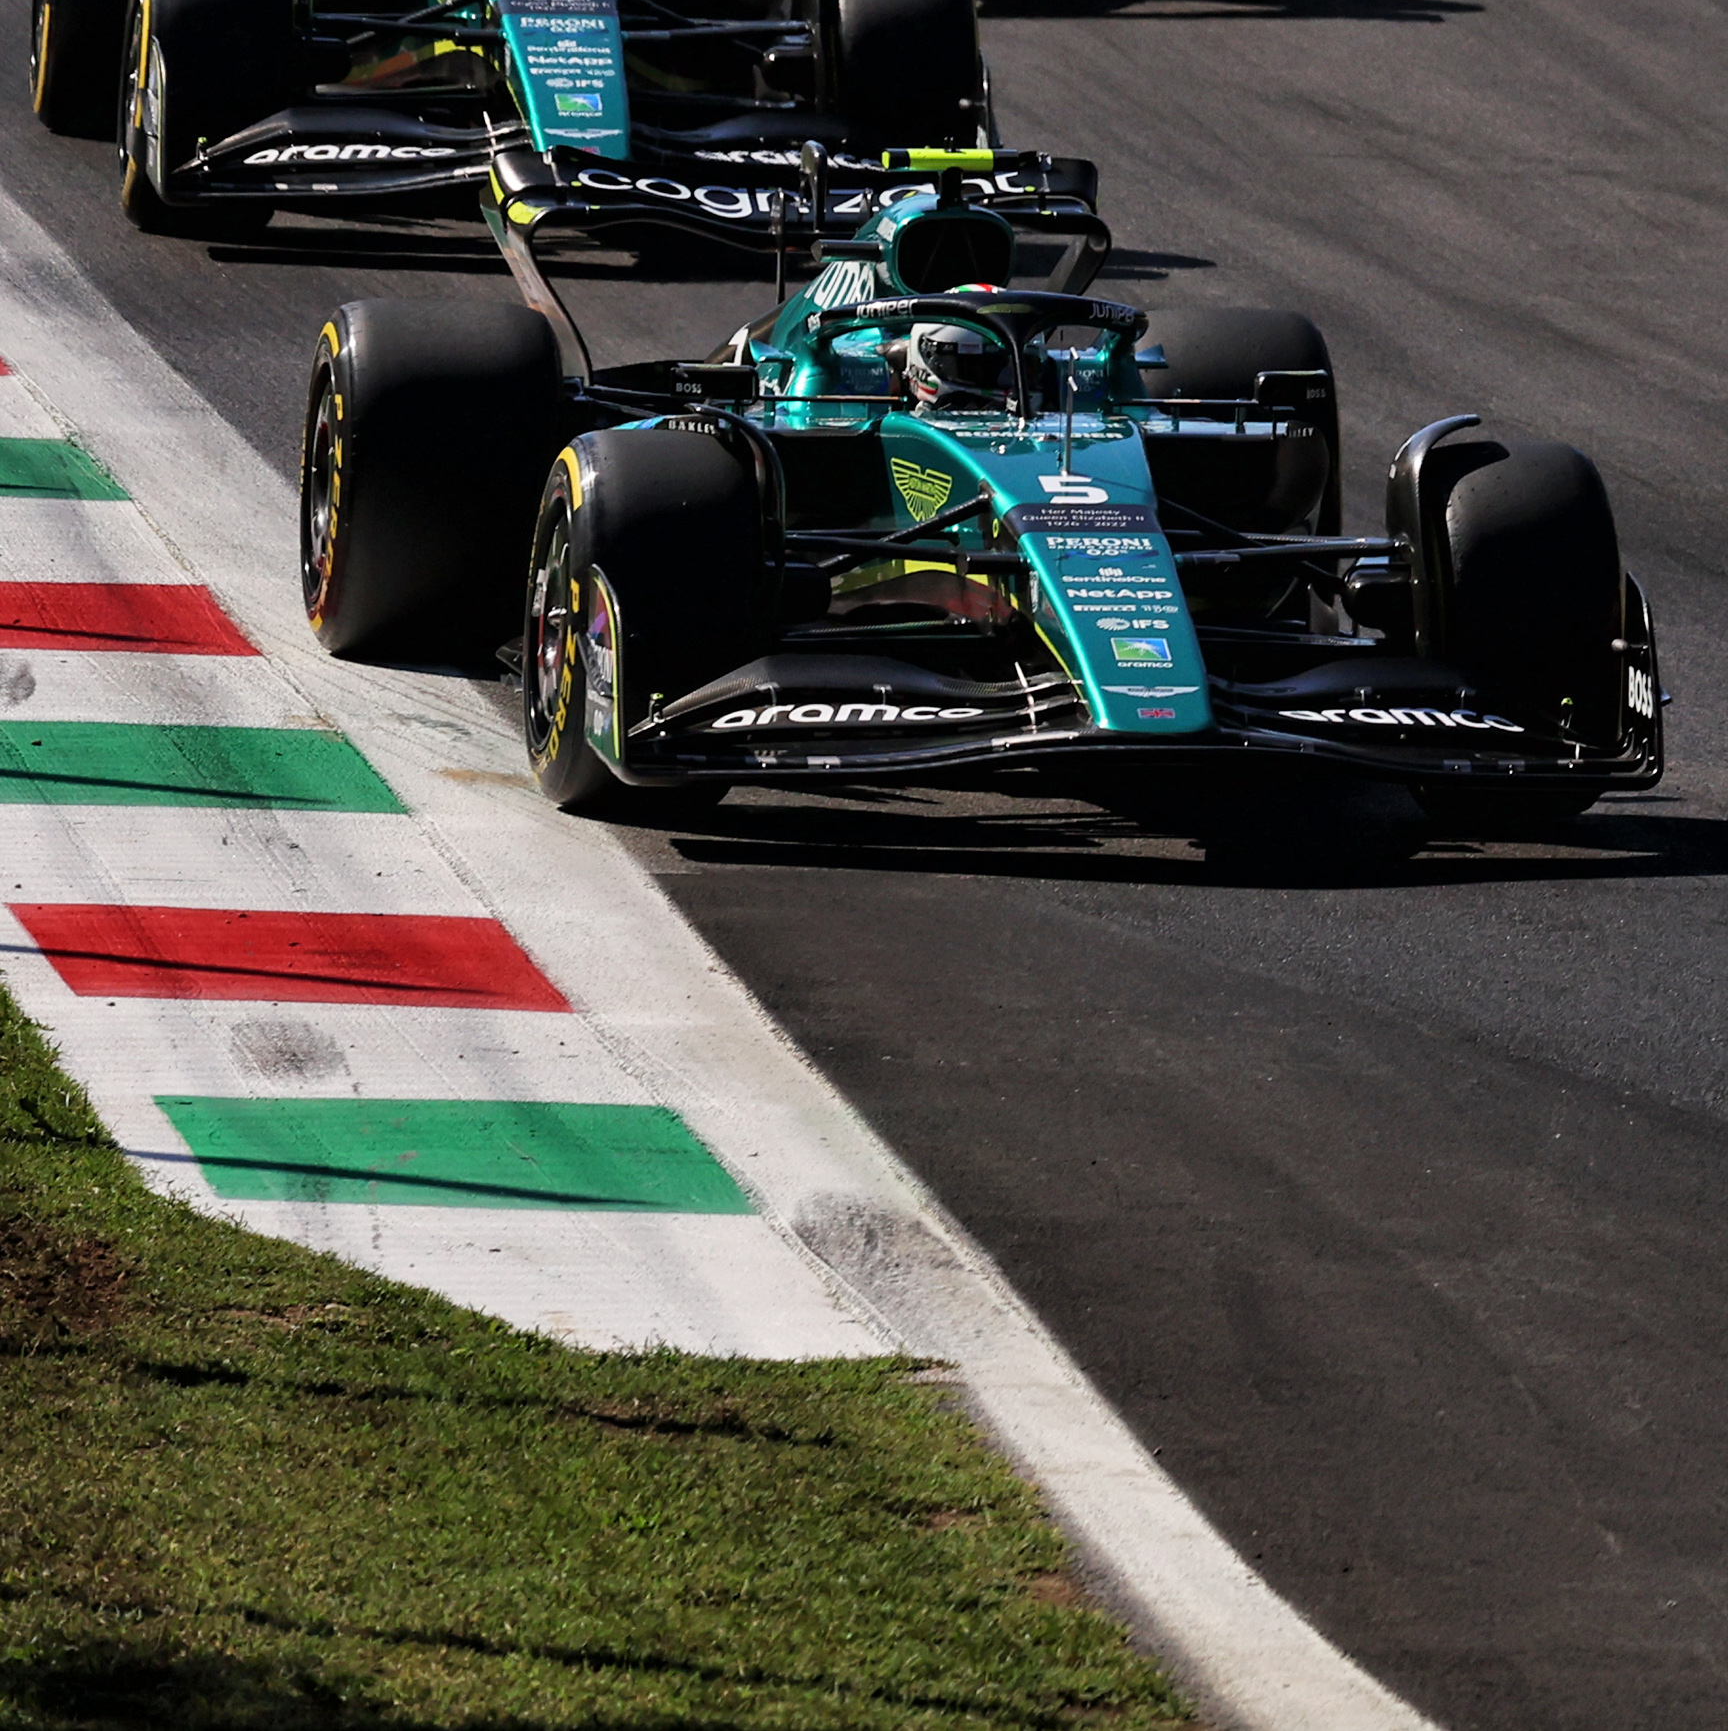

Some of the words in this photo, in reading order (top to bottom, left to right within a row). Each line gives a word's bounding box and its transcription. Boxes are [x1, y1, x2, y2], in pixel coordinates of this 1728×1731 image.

[245, 145, 456, 164] aramco
[675, 382, 702, 394] BOSS
[1038, 475, 1108, 505] 5
[1022, 514, 1068, 522] Queen
[1093, 520, 1128, 528] 2022
[1046, 536, 1153, 547] PERONI
[1061, 575, 1167, 583] SentinelOne
[1066, 588, 1173, 599] NetApp
[1131, 619, 1170, 629] IFS
[1117, 661, 1174, 669] aramco
[1628, 666, 1654, 719] BOSS
[711, 703, 984, 730] aramco
[1278, 707, 1525, 732] aramco
